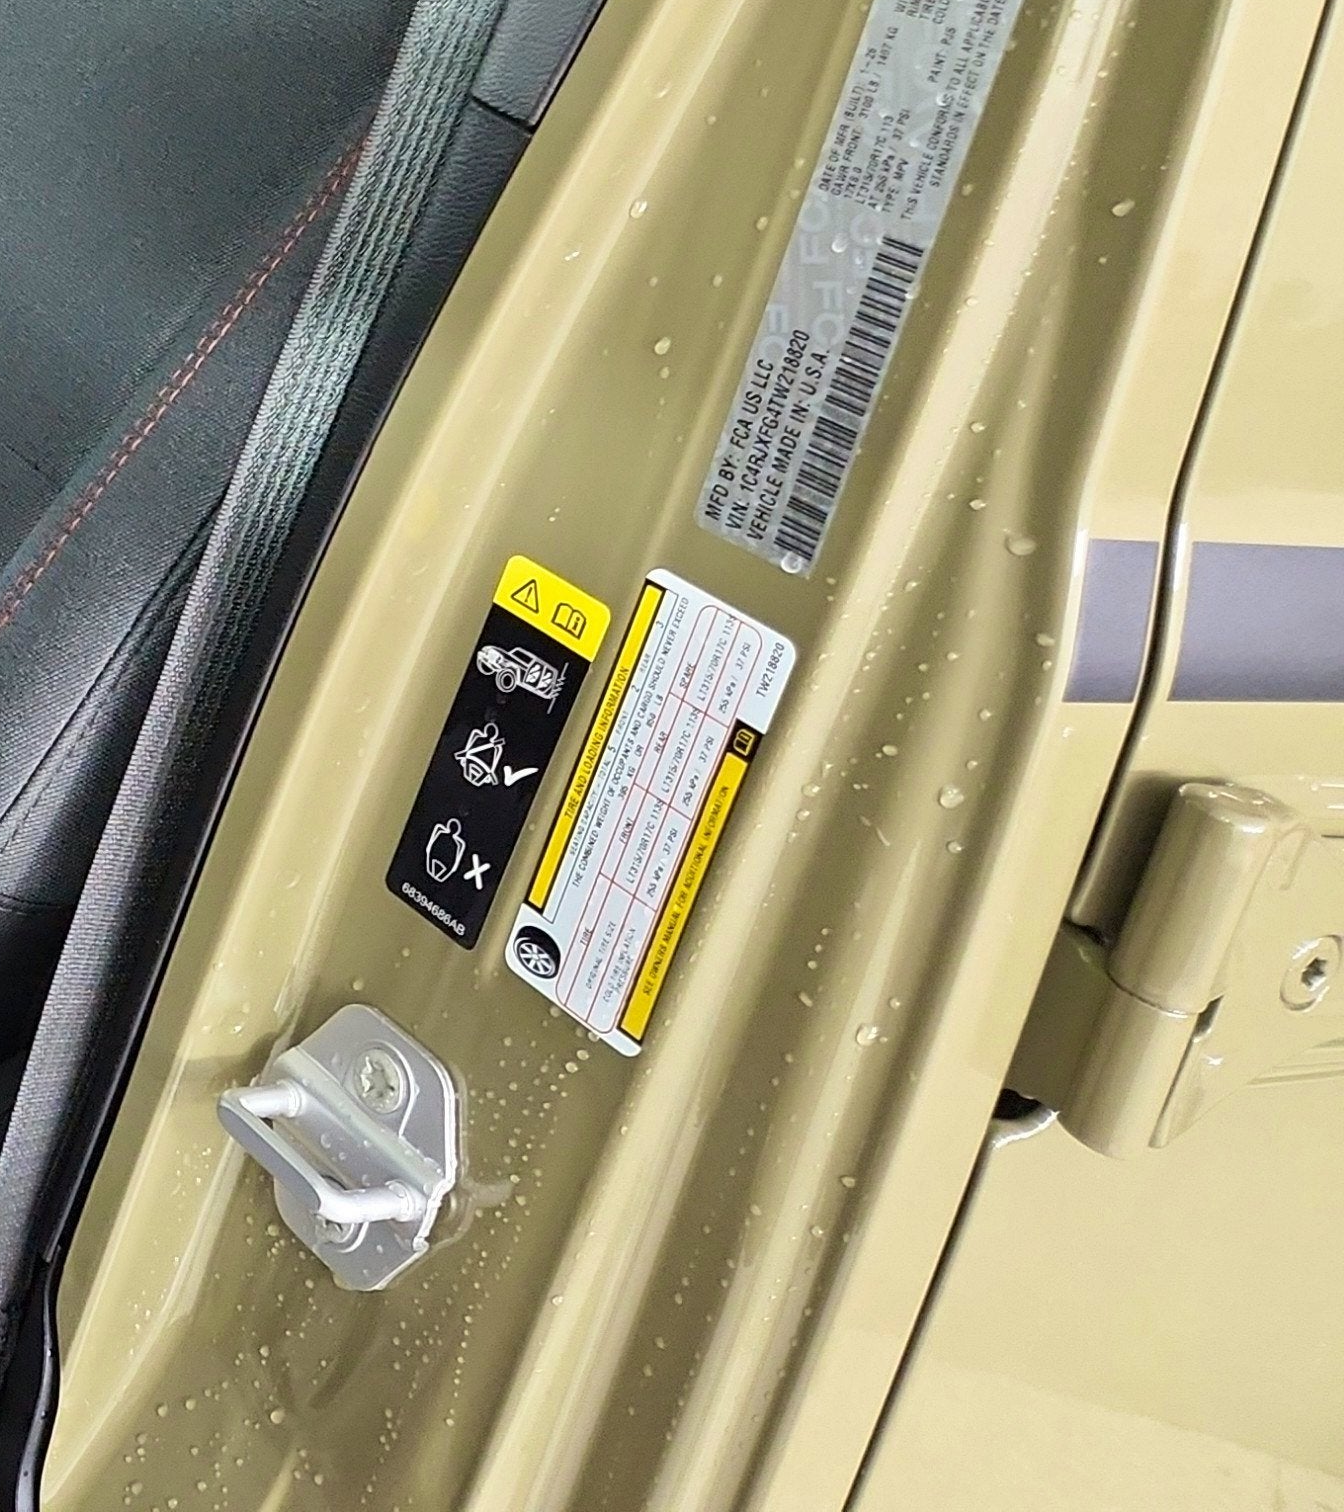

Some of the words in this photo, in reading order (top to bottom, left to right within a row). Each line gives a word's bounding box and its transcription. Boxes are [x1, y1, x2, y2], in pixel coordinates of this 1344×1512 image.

[977, 29, 995, 48] THE
[952, 57, 968, 75] ALL
[972, 51, 986, 67] ON
[946, 76, 961, 90] TO
[956, 69, 979, 108] EFFECT
[830, 164, 849, 195] GAWR
[857, 94, 874, 118] 3100
[866, 79, 879, 93] LB
[885, 26, 898, 39] KG
[880, 114, 894, 131] 113
[896, 108, 910, 125] PSI
[953, 111, 965, 122] IN
[891, 127, 903, 140] 37
[818, 165, 835, 190] DATE
[827, 149, 840, 162] OF
[834, 123, 849, 146] MFR
[892, 157, 908, 180] MPV
[930, 125, 959, 186] STANDARDS
[910, 152, 933, 194] VEHICLE
[867, 194, 880, 209] AT
[899, 196, 917, 219] THIS
[750, 358, 773, 389] LLC
[798, 350, 829, 395] U.S.A.
[741, 390, 762, 414] US
[789, 399, 810, 423] IN:
[725, 499, 749, 529] VIN:
[740, 330, 808, 490] 1C4RJXFG4TW218820
[729, 418, 753, 449] FCA
[771, 425, 800, 473] MADE
[718, 454, 739, 481] BY:
[704, 483, 728, 520] MFD
[747, 476, 782, 539] VEHICLE
[734, 656, 744, 670] 37
[739, 642, 751, 657] PSI
[755, 642, 784, 696] TW218820
[678, 662, 695, 689] SPARE
[563, 795, 579, 818] TIRE
[573, 774, 587, 796] AND
[582, 732, 603, 774] LOADING
[598, 666, 628, 731] INFORMATION
[571, 871, 583, 887] THE
[578, 829, 598, 870] COMBINED
[595, 797, 610, 828] WEIGHT
[606, 785, 615, 797] OF
[611, 737, 634, 785] OCCUPANTS
[630, 719, 641, 736] AND
[636, 690, 652, 719] CARGO
[648, 657, 665, 690] SHOULD
[661, 629, 676, 655] NEVER
[671, 596, 688, 628] EXCEED
[698, 750, 707, 763] 37
[703, 735, 714, 751] PSI
[618, 816, 635, 844] FRONT
[666, 827, 678, 843] PSI
[662, 841, 671, 855] 37
